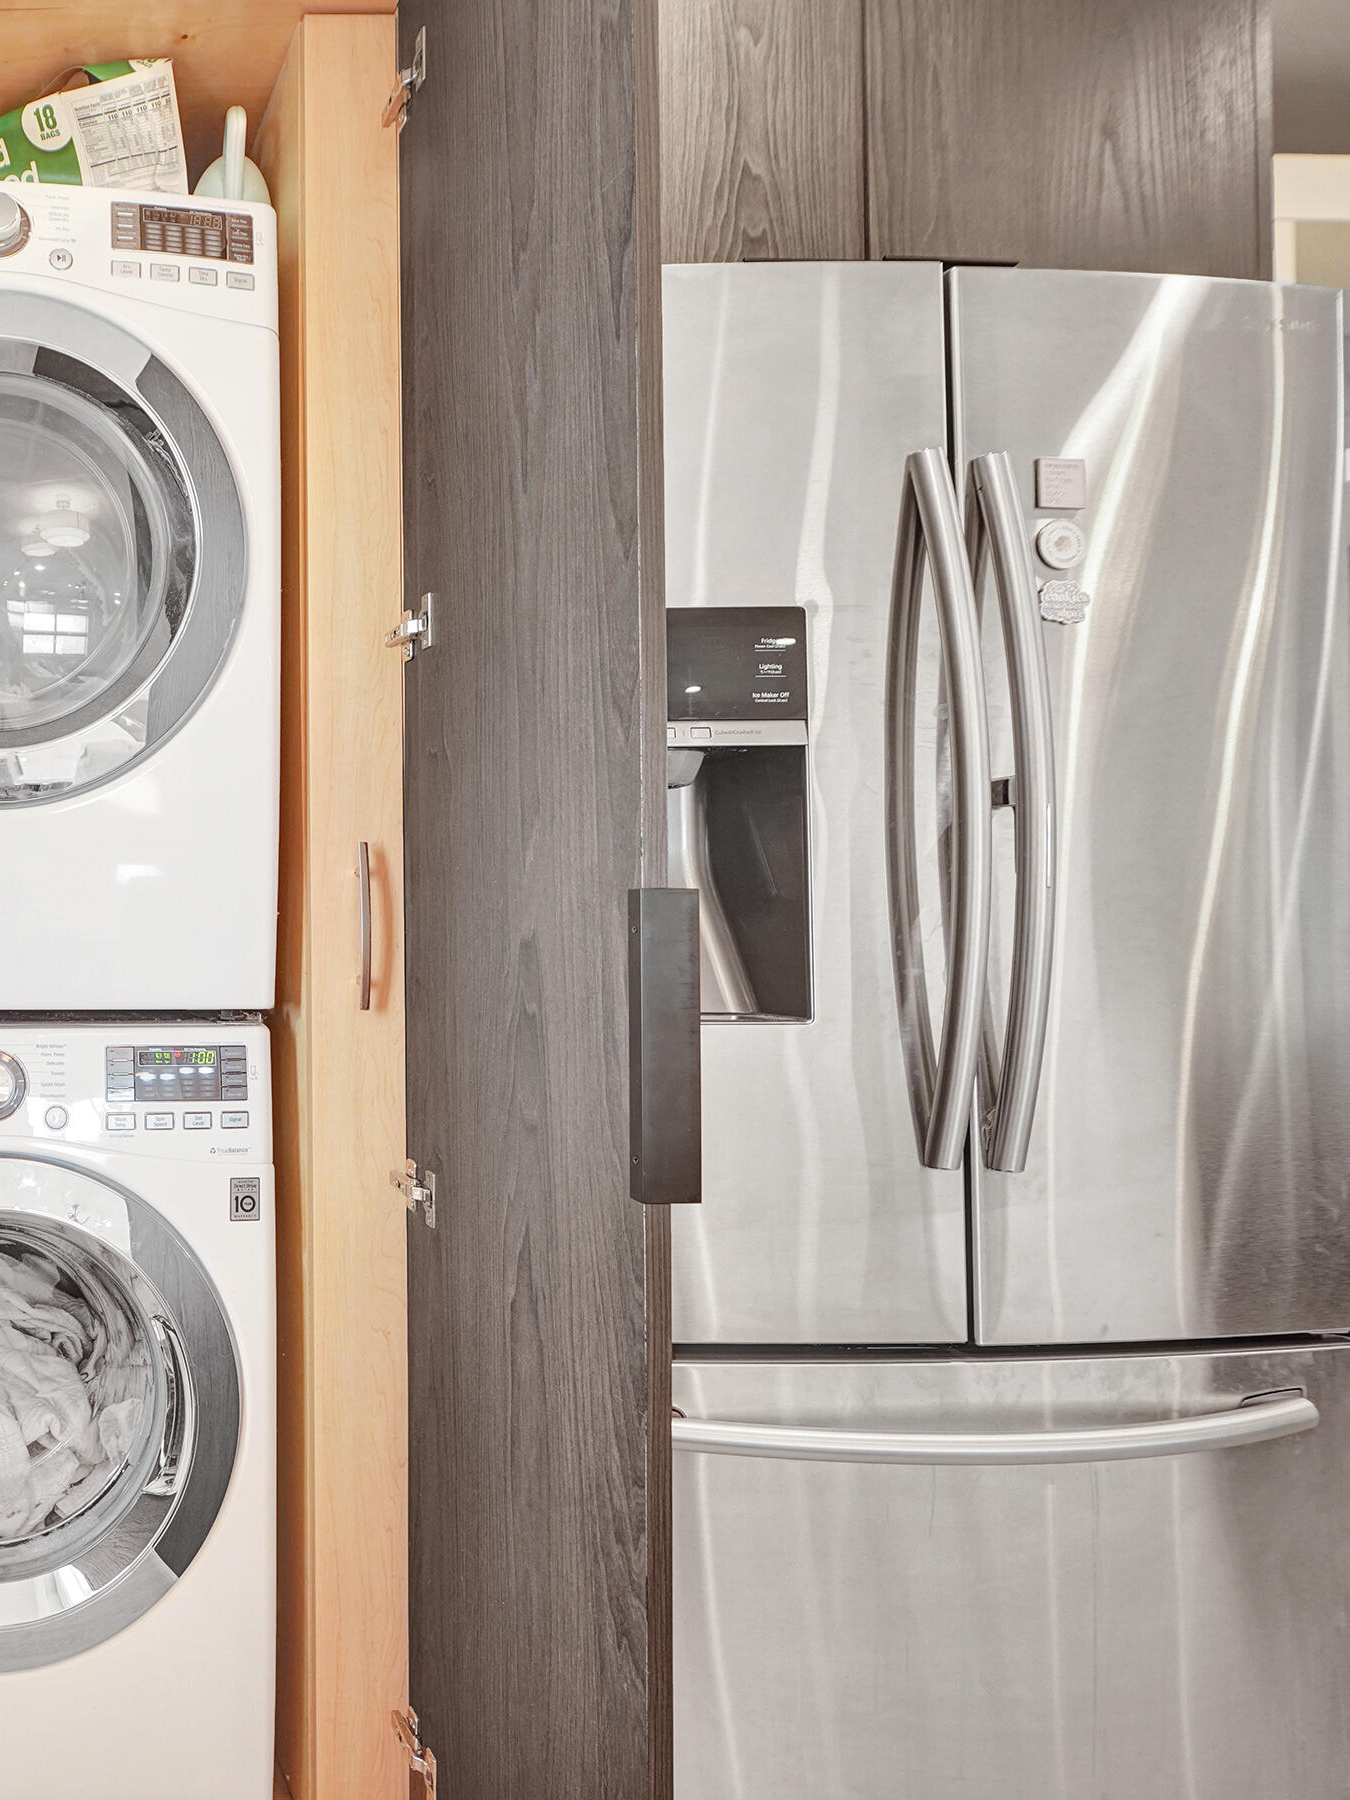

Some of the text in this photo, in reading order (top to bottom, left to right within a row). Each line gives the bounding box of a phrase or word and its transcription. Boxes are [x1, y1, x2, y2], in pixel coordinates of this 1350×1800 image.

[33, 104, 58, 133] 18
[40, 128, 61, 141] BAGS
[758, 663, 783, 671] Lighting
[192, 1051, 214, 1065] 1:00
[234, 1195, 256, 1213] 10
